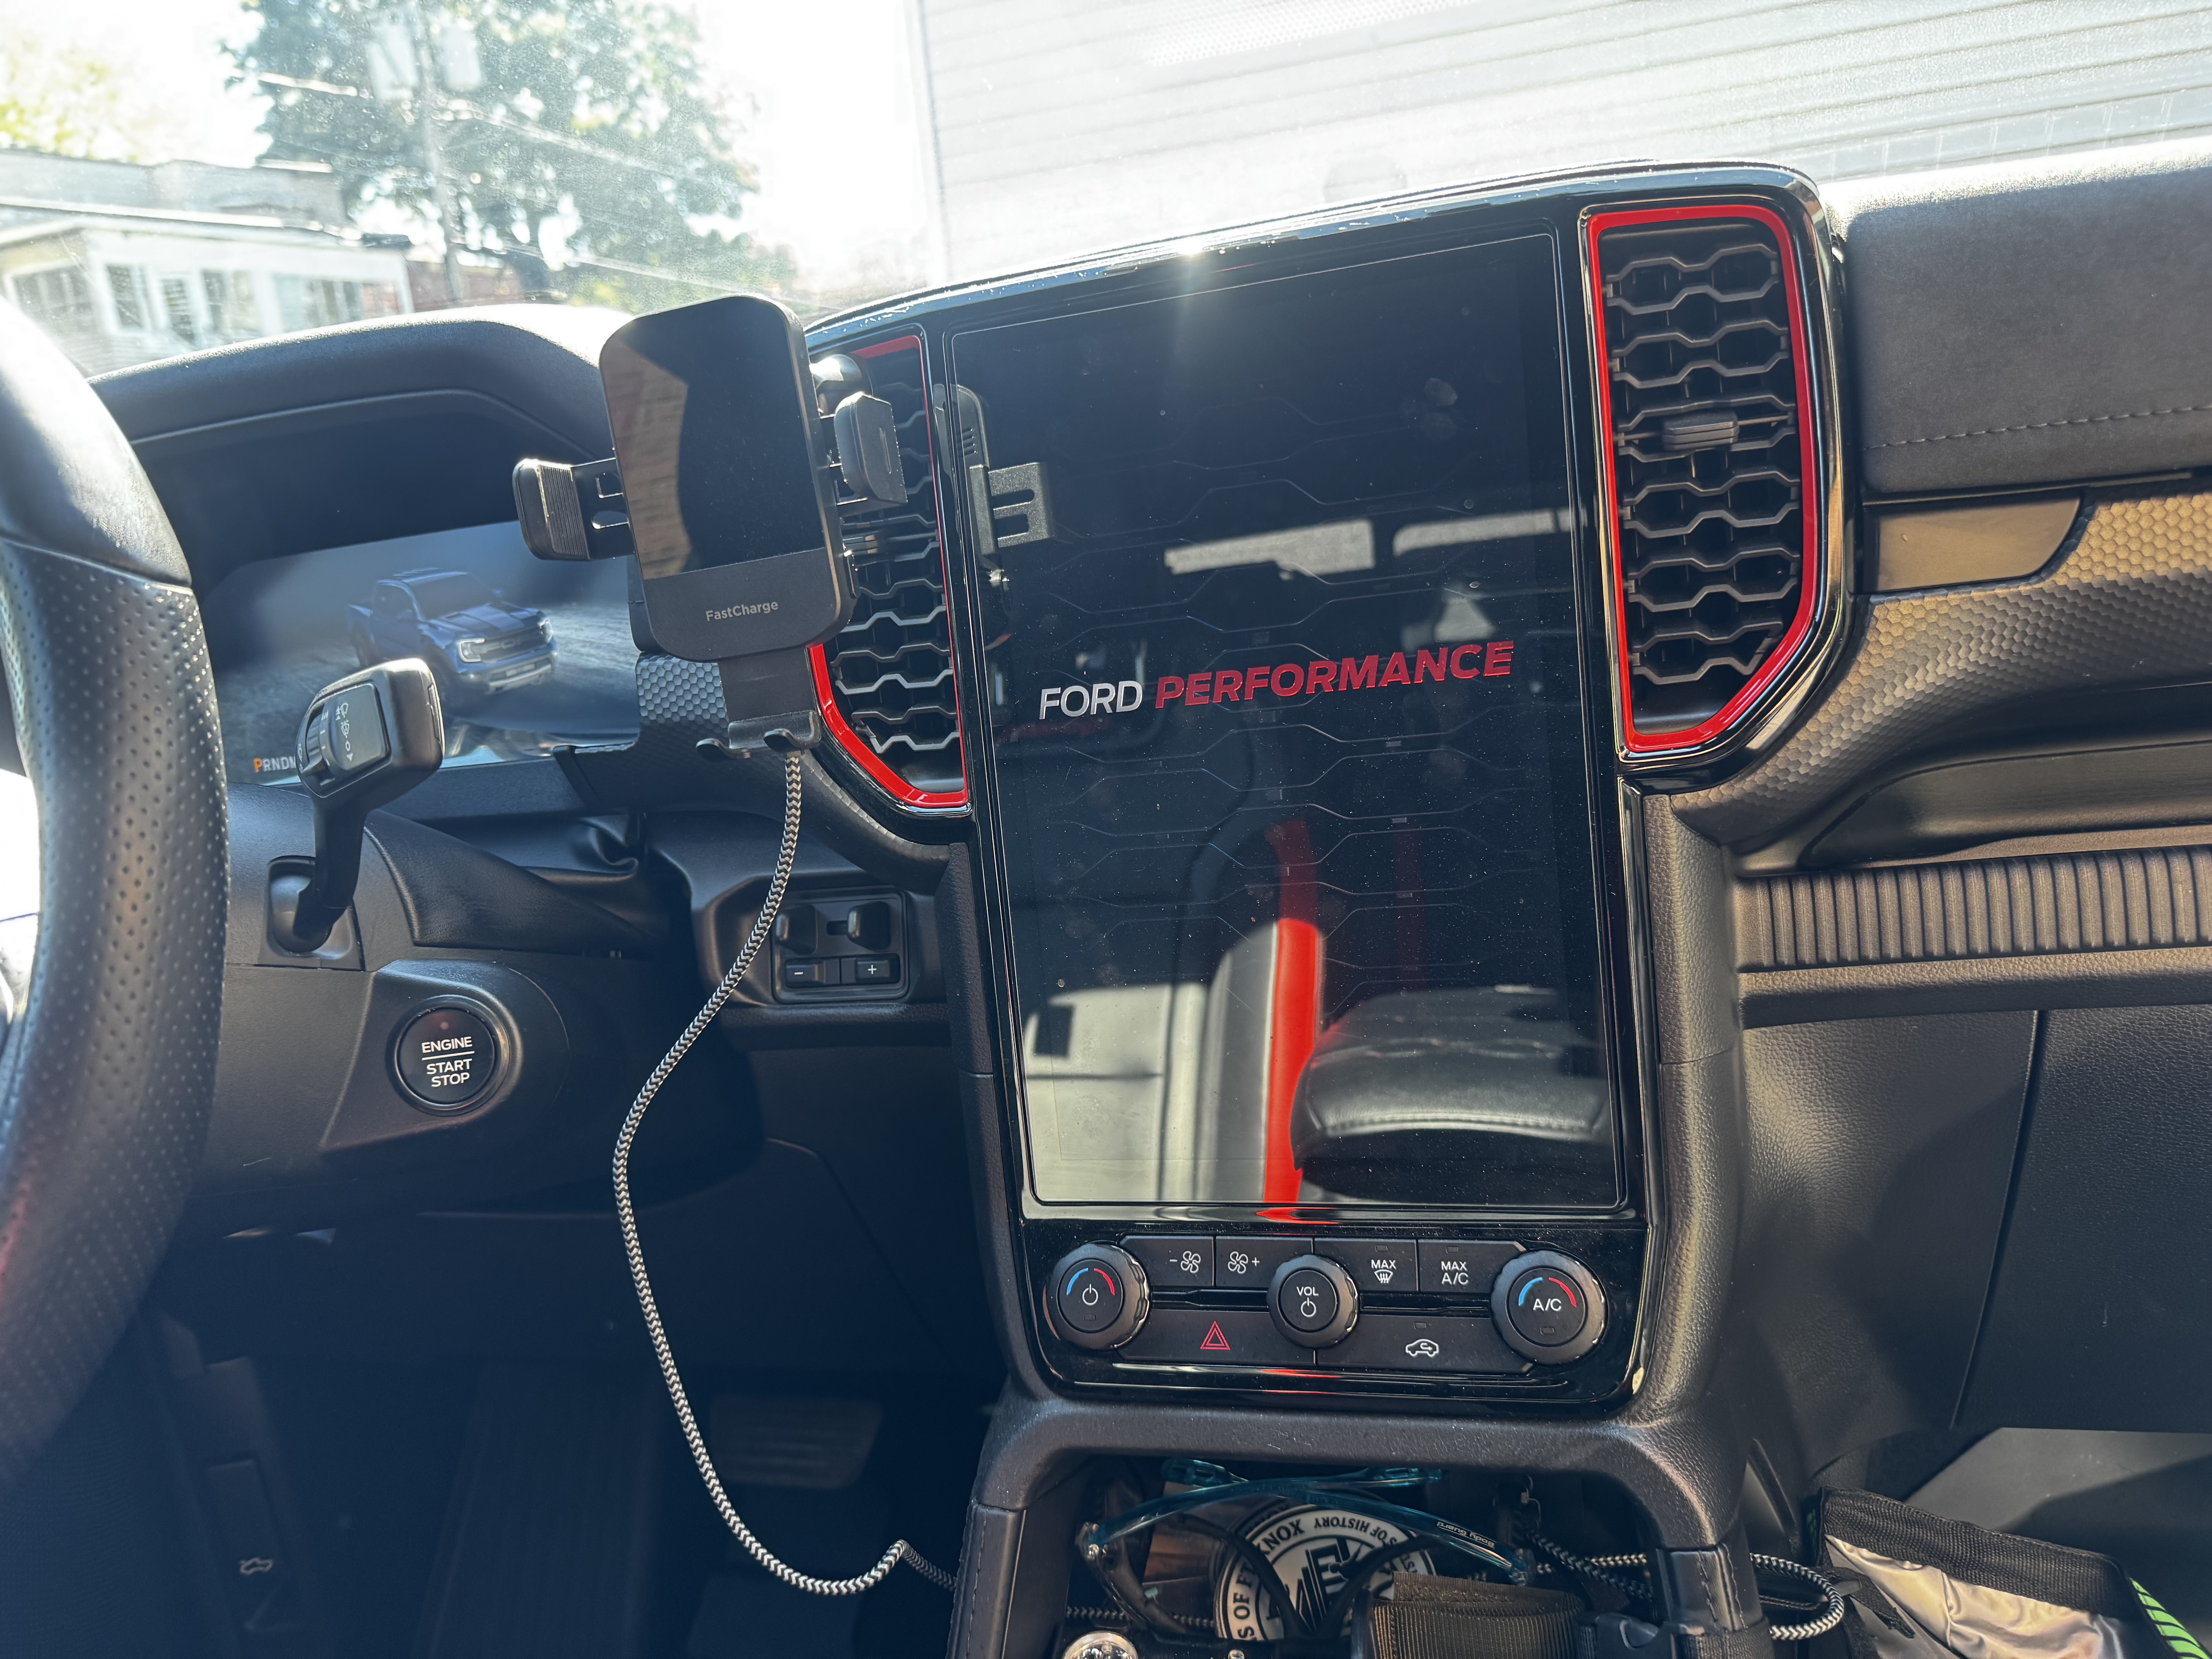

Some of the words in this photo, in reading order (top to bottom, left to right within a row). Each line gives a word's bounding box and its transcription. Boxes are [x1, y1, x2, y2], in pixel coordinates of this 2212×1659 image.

[706, 601, 778, 621] FastCharge
[1039, 680, 1143, 720] FORD
[1154, 640, 1514, 709] PERFORMANCE
[422, 1036, 472, 1053] ENGINE
[427, 1058, 472, 1075] START
[431, 1072, 470, 1087] STOP
[1371, 1259, 1396, 1269] MAX
[1441, 1261, 1467, 1271] MAX
[1441, 1273, 1469, 1285] A/C
[1297, 1286, 1319, 1296] VOL
[1533, 1298, 1561, 1311] A/C
[1314, 1516, 1371, 1533] HISTORY
[1233, 1592, 1250, 1620] OF
